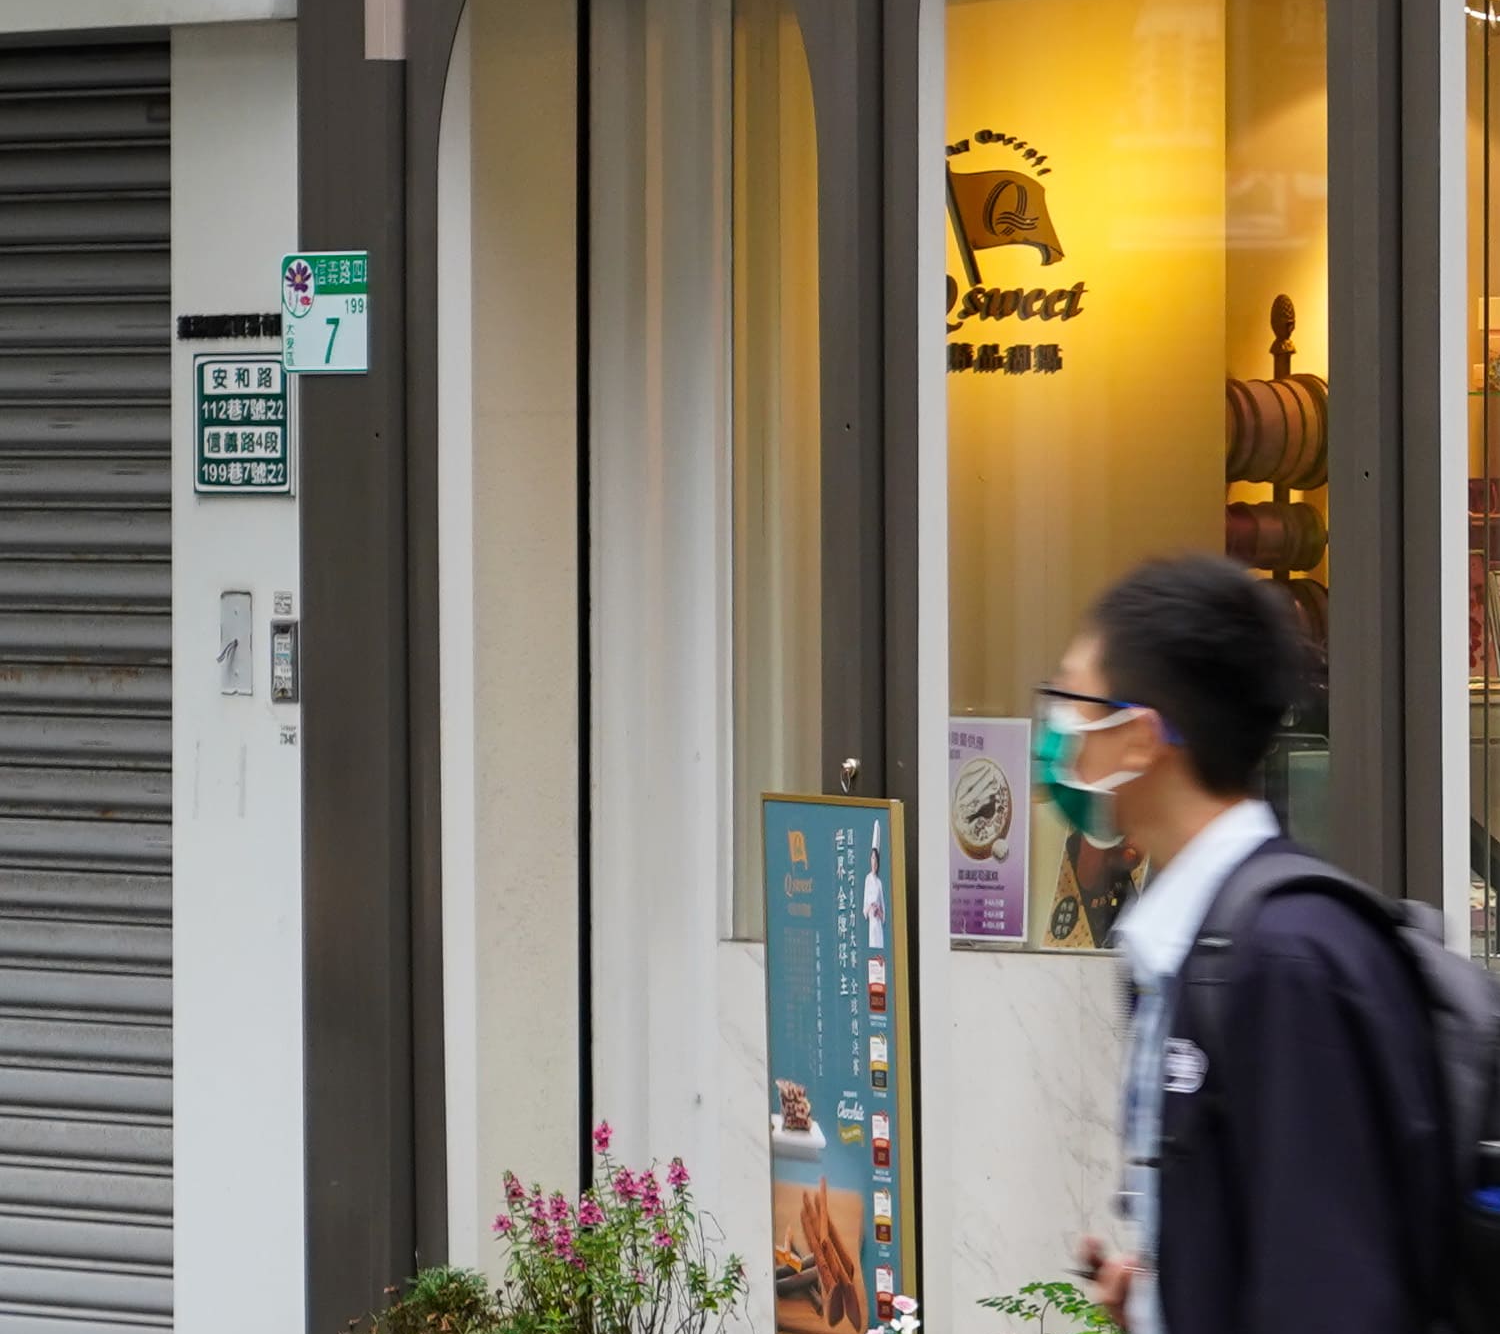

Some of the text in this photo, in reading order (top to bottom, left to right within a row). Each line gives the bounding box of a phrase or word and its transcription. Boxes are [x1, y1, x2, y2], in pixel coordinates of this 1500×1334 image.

[315, 259, 367, 285] 信義路四
[325, 318, 340, 364] 7
[212, 367, 272, 389] 安和路
[202, 399, 284, 421] 112巷7號之2
[207, 431, 279, 453] 信義路4段
[202, 461, 284, 484] 199巷7號之2
